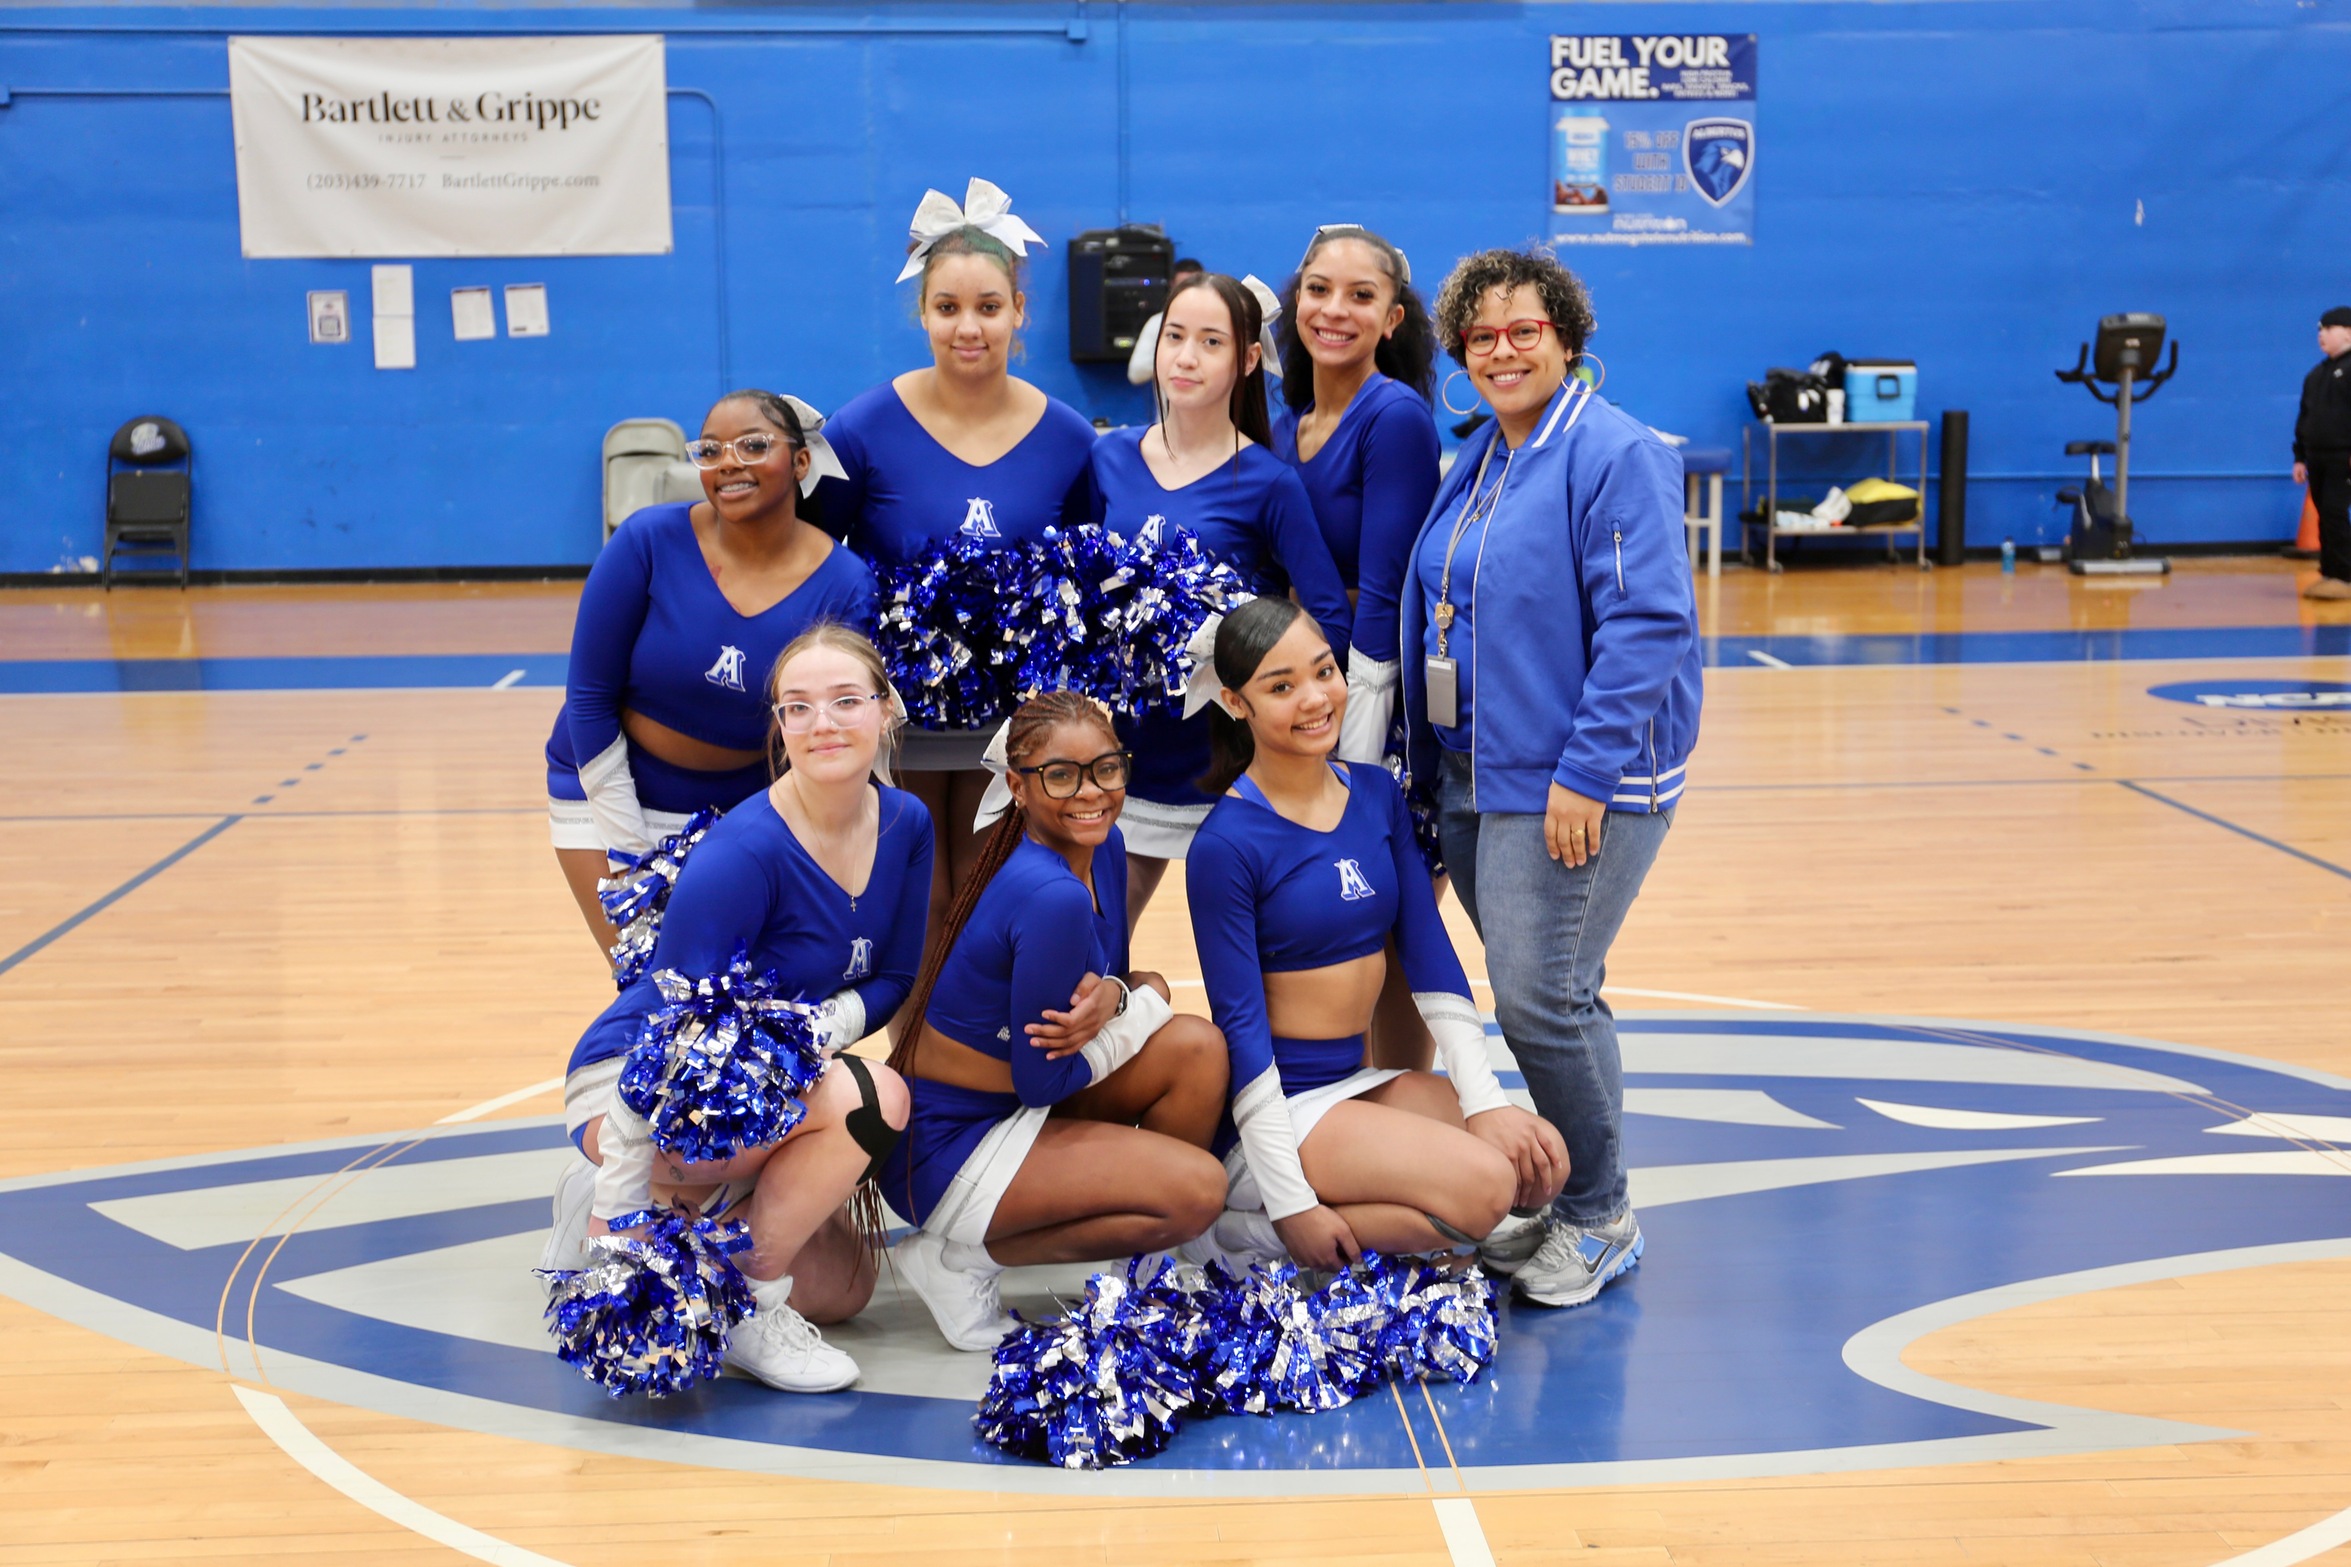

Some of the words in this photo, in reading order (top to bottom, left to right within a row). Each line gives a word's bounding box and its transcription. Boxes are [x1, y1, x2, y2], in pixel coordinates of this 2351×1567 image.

[1551, 36, 1630, 68] FUEL
[1632, 36, 1731, 68] YOUR
[1551, 67, 1660, 99] GAME.
[302, 90, 440, 123] Bartlett
[446, 98, 471, 122] &
[476, 91, 600, 130] Grippe
[378, 133, 433, 143] INJURY
[442, 132, 529, 143] ATTORNEYS
[1655, 131, 1681, 149] OFF
[1633, 152, 1671, 171] WITH
[442, 172, 600, 191] BartlettGrippe.com
[1614, 173, 1671, 192] STUDENT
